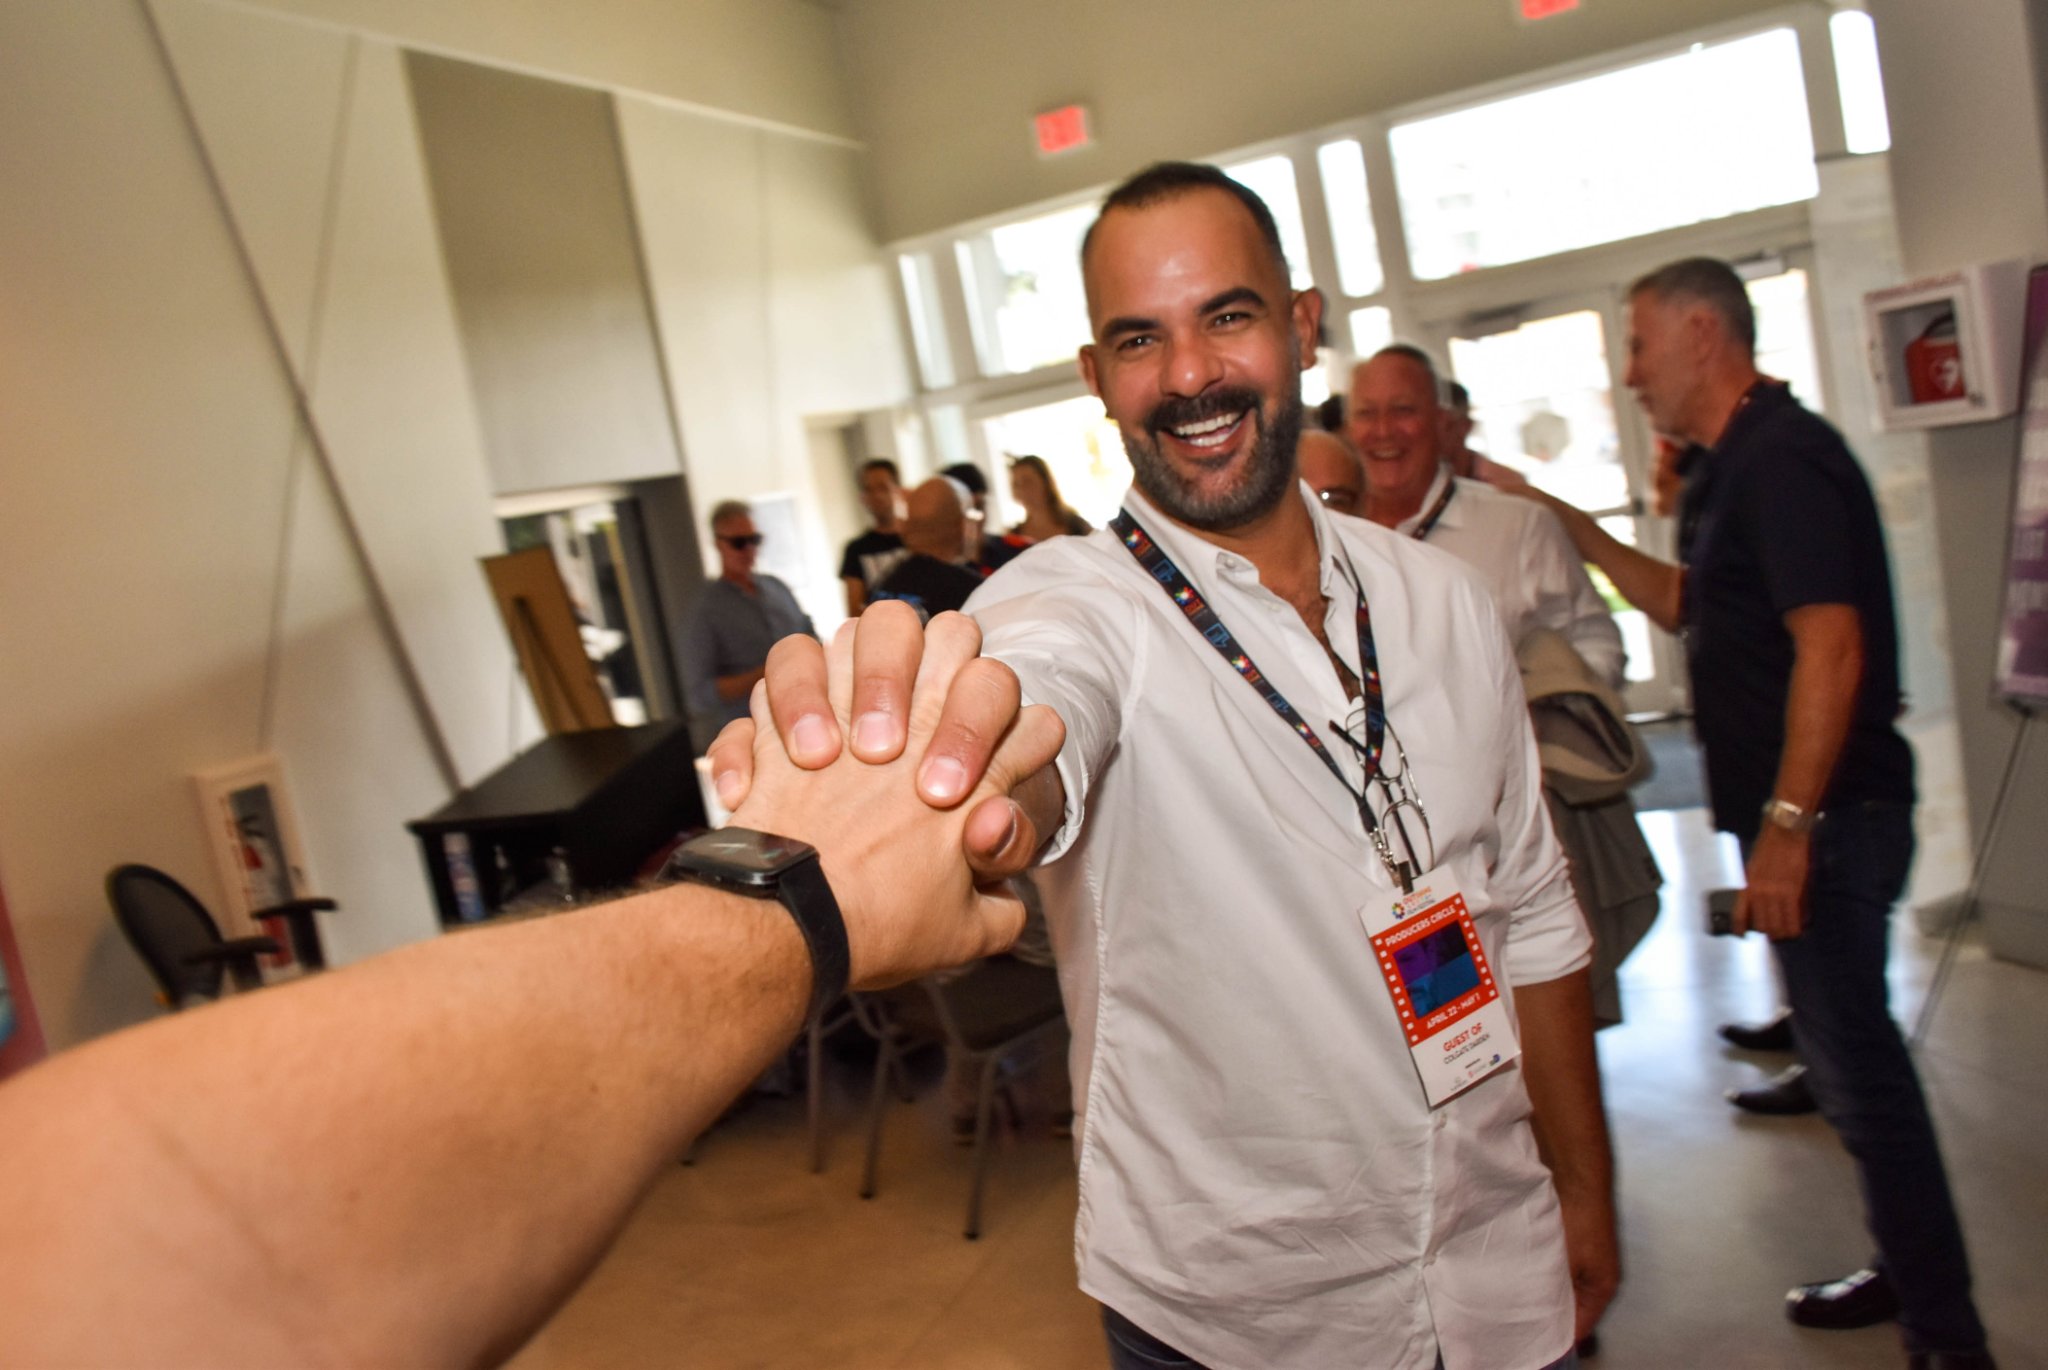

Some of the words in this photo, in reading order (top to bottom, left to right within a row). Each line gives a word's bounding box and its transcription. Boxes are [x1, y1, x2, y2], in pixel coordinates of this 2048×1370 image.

[1385, 917, 1431, 947] PRODUCERS
[1430, 904, 1456, 925] CIRCLE
[1427, 1012, 1448, 1029] APRIL
[1447, 1005, 1458, 1017] 22
[1460, 995, 1475, 1010] MAY
[1443, 1029, 1469, 1052] GUEST
[1471, 1022, 1483, 1036] OF
